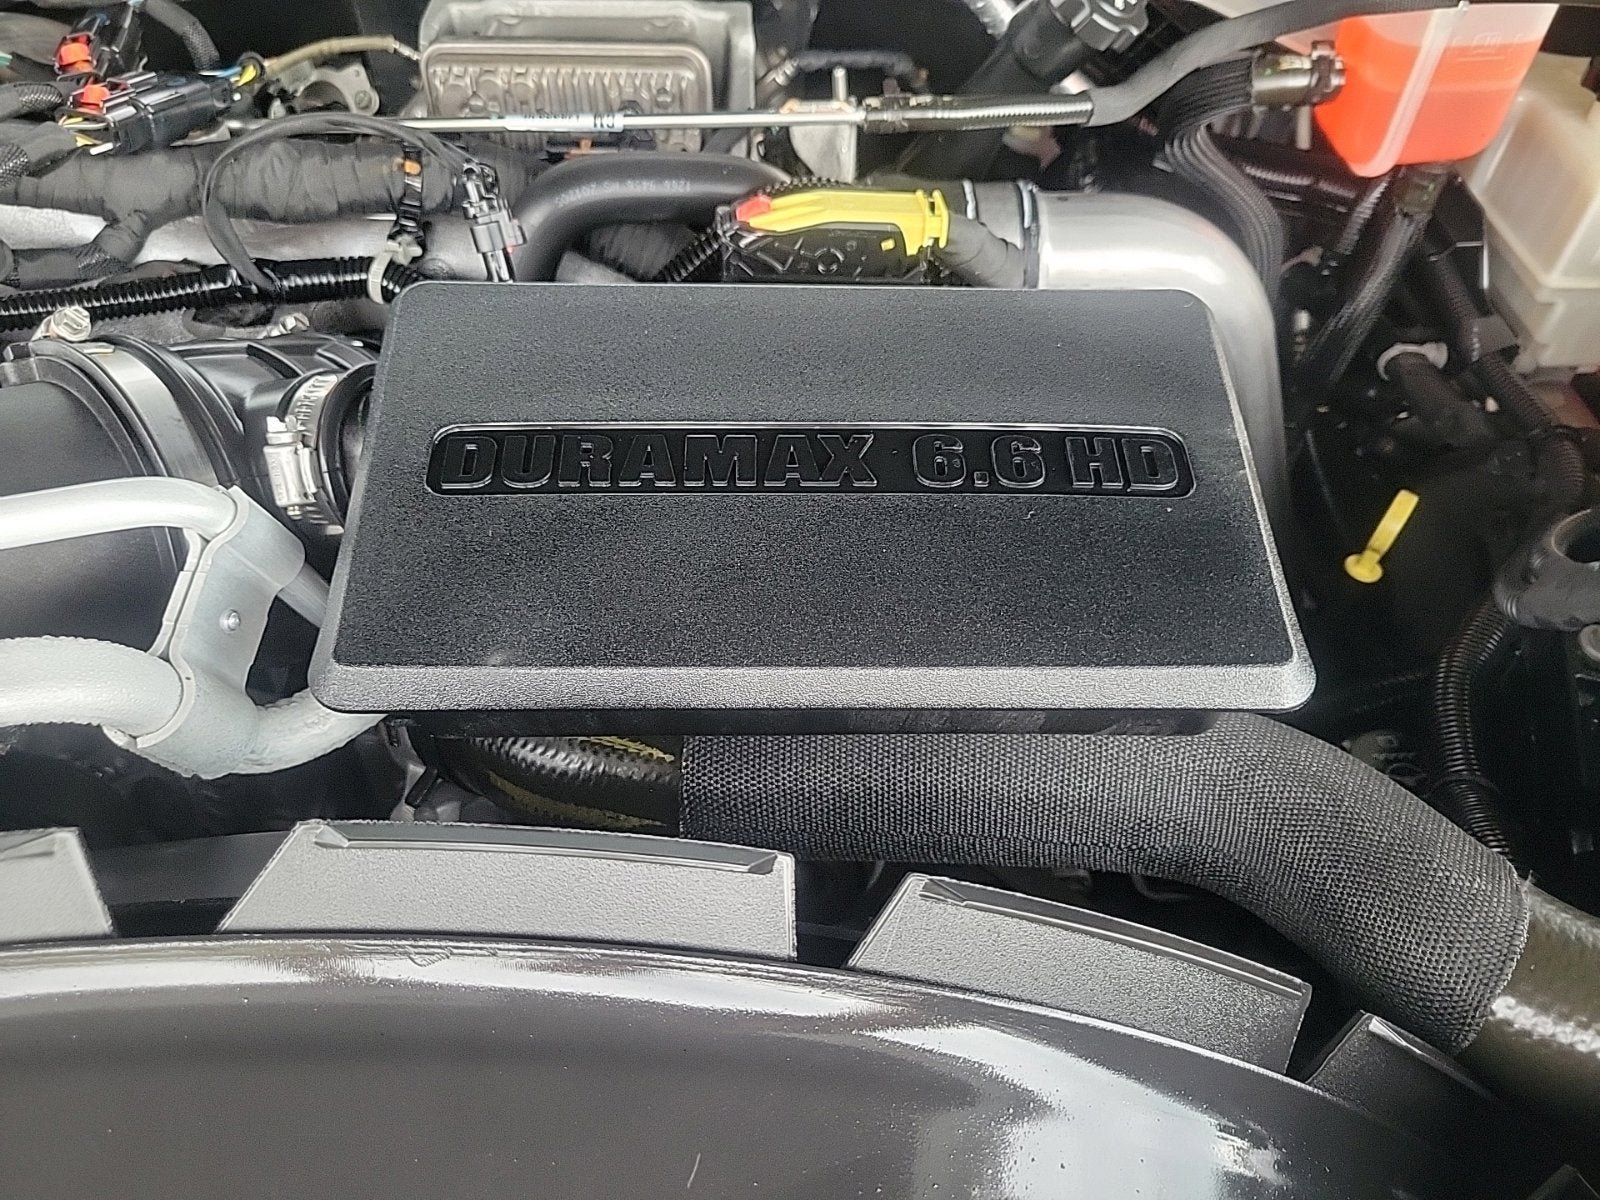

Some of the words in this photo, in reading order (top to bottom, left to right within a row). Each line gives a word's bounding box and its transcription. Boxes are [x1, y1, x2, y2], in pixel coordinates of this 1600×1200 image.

[440, 433, 877, 489] DURAMAX
[912, 433, 1046, 488] 6.6
[1065, 436, 1179, 491] HD
